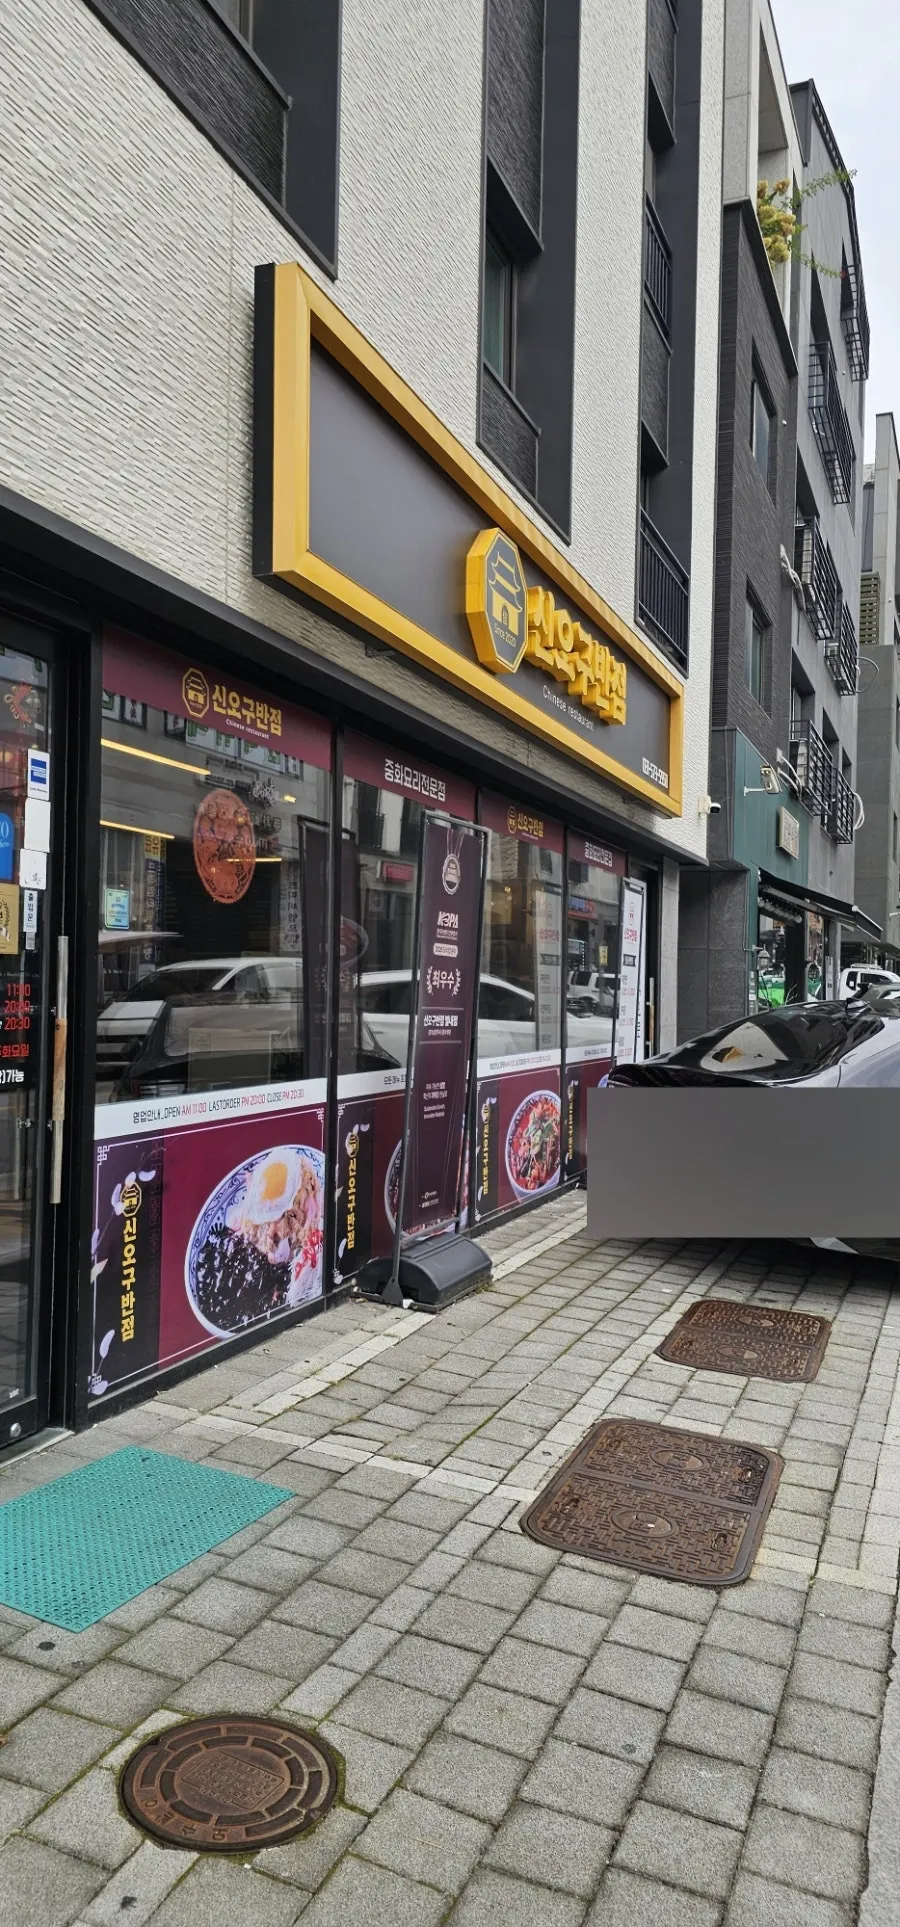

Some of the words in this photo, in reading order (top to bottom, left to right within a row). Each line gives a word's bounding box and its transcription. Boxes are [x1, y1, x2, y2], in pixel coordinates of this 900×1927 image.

[526, 586, 627, 726] 신오구반점
[212, 684, 282, 736] 신오구반점
[542, 684, 567, 712] Chinese
[225, 718, 245, 731] Chinese
[245, 726, 269, 740] restaurant
[384, 758, 446, 802] 중화요리전문점
[517, 812, 544, 838] 신오구반점
[432, 969, 455, 990] 최우수
[4, 1016, 31, 1031] 20:30
[0, 1068, 25, 1084] )가능
[181, 1105, 192, 1116] AM
[347, 1157, 357, 1250] 신오구반점
[121, 1216, 138, 1343] 신오구반점
